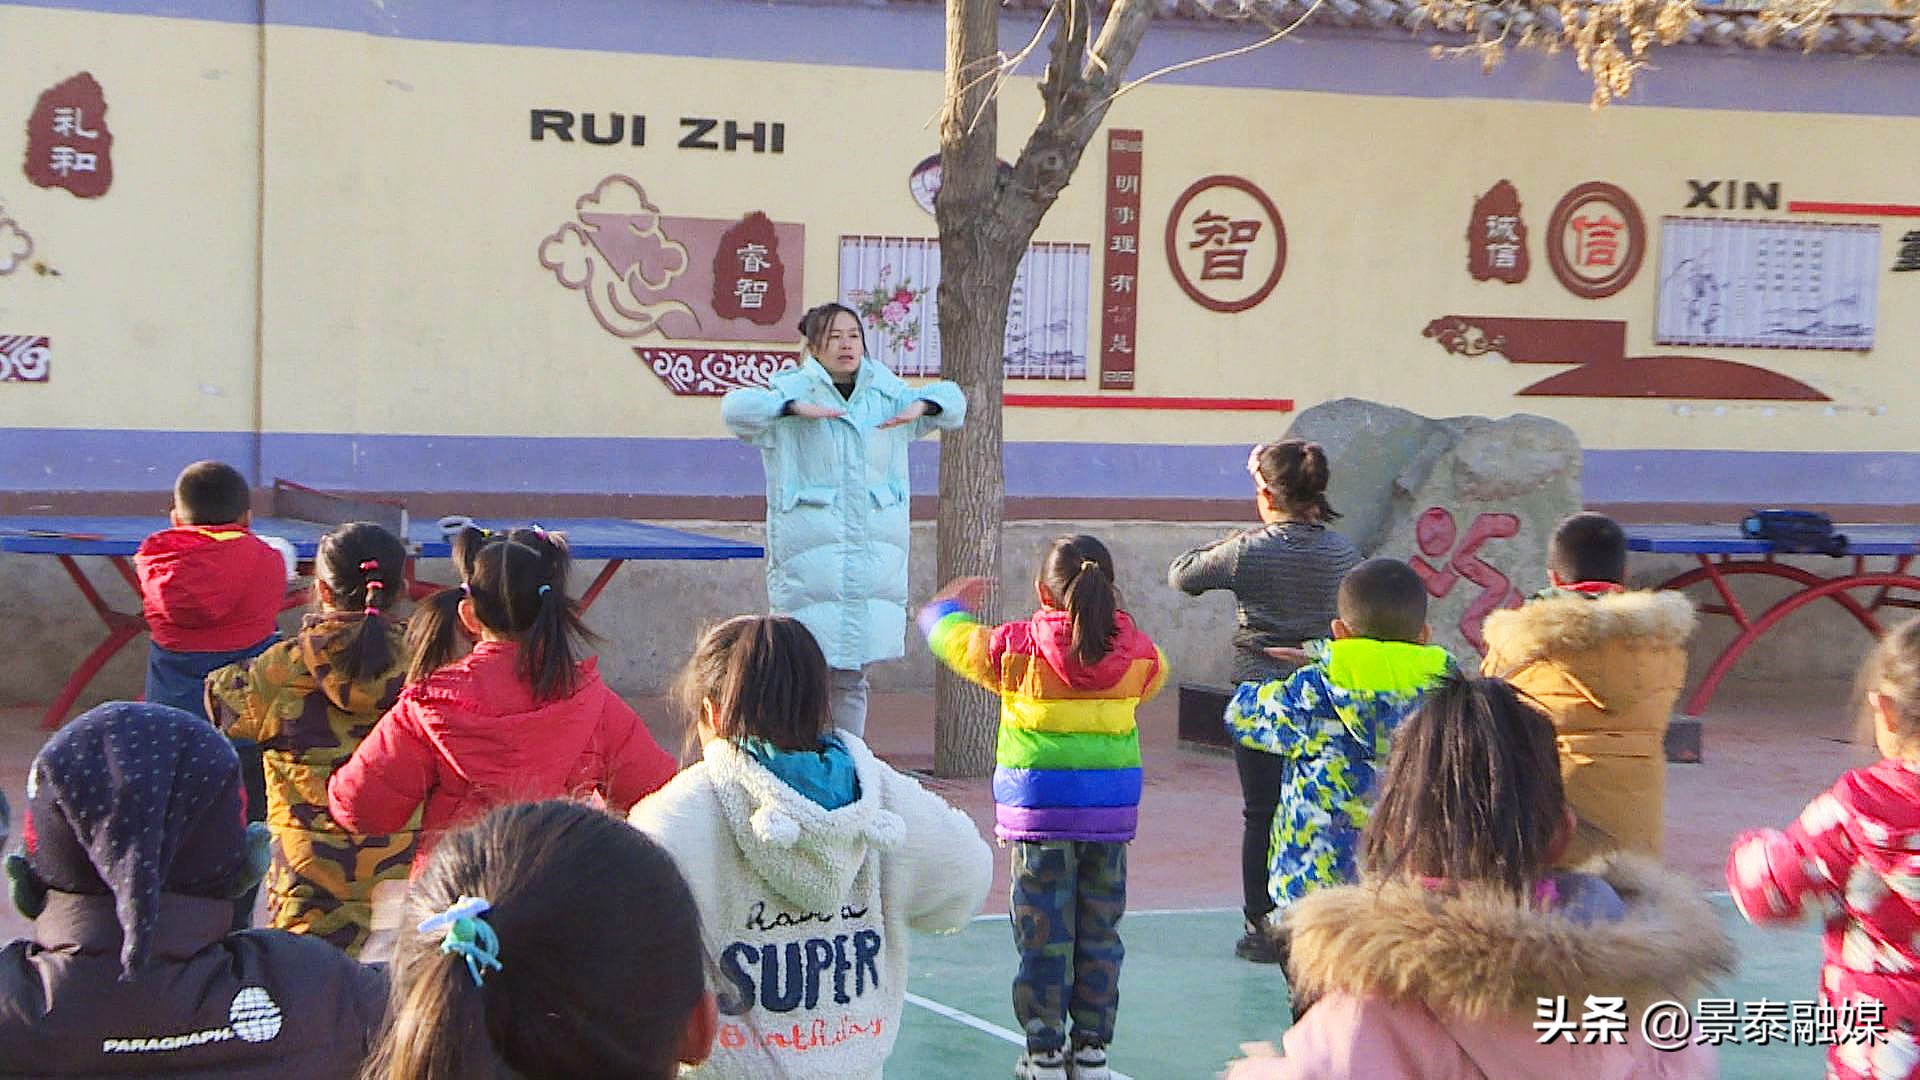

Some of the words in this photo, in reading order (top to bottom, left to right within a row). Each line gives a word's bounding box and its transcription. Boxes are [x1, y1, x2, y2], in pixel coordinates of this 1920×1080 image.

[49, 106, 99, 177] 礼和
[530, 109, 646, 147] RUI
[678, 117, 785, 153] ZHI
[1686, 180, 1780, 210] XIN
[1189, 209, 1262, 280] 智
[1485, 215, 1521, 268] 诚信
[1571, 214, 1624, 268] 信
[734, 242, 771, 309] 睿智
[716, 929, 881, 1016] SUPER
[103, 1027, 235, 1053] PARAGRAPH
